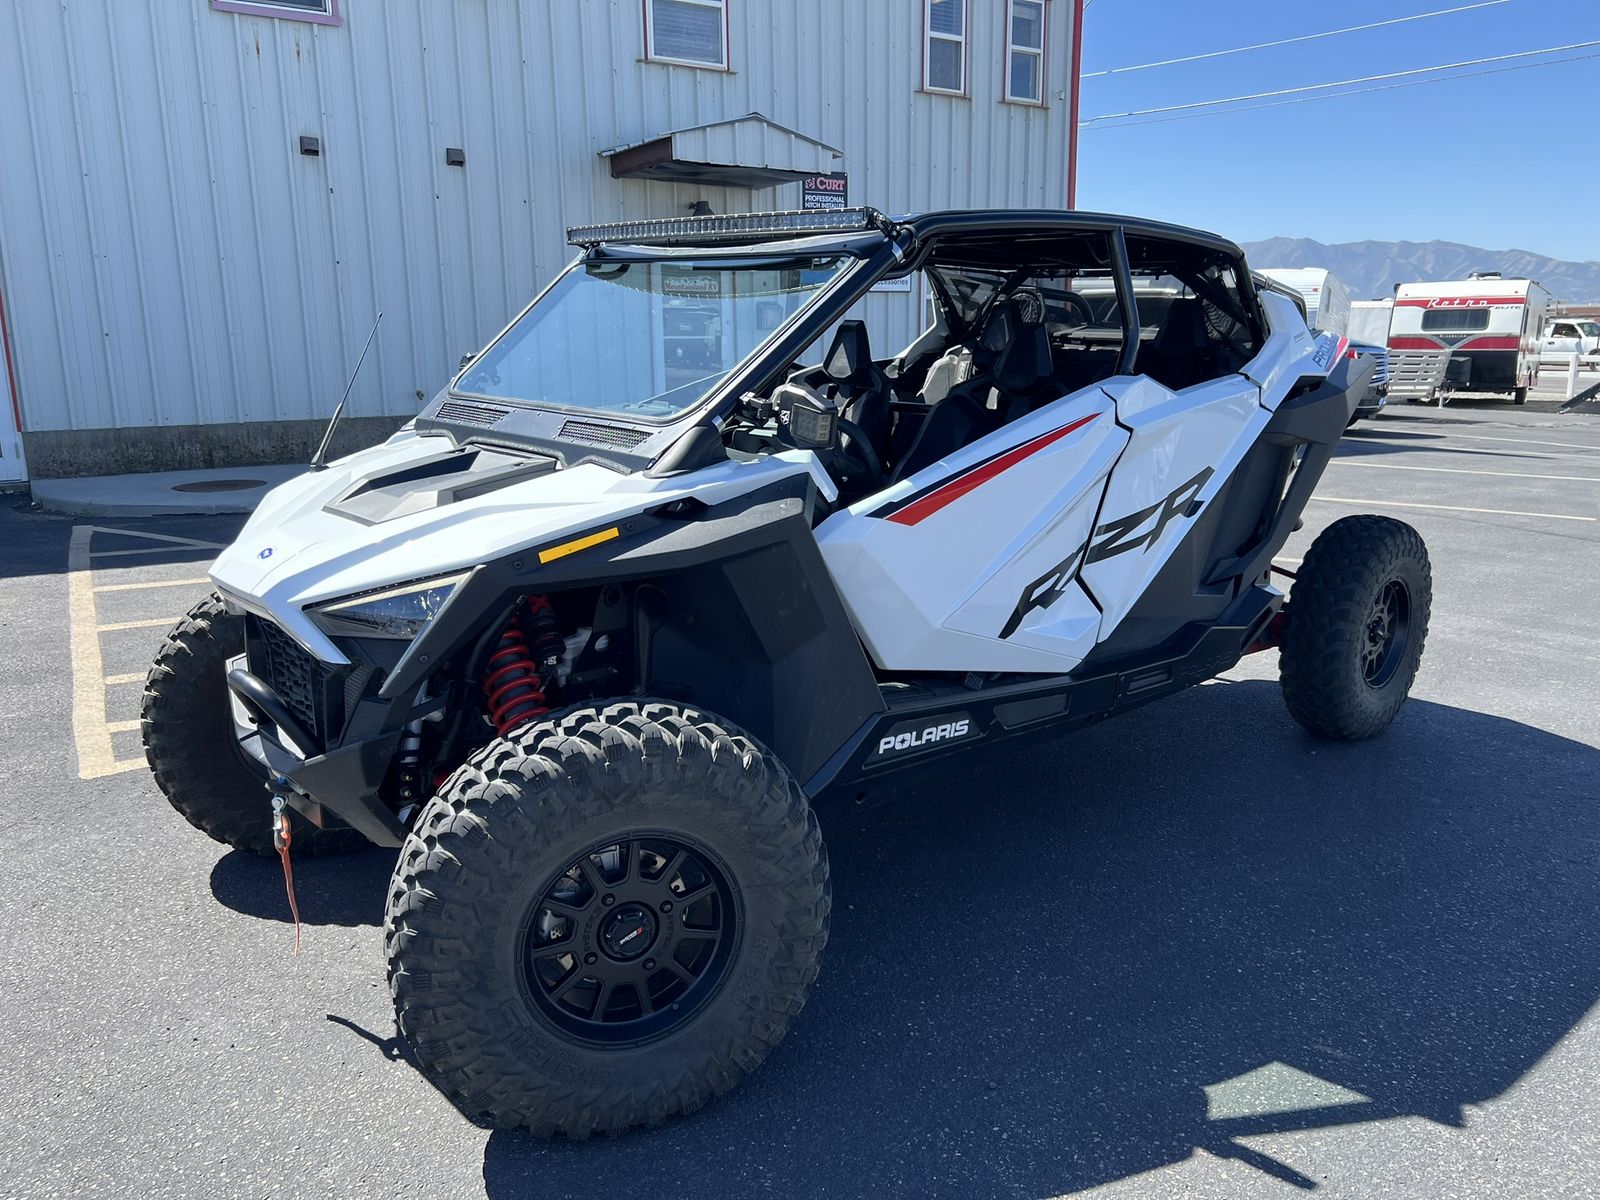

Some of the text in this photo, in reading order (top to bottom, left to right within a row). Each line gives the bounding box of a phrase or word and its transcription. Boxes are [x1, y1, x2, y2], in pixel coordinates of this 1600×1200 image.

[816, 177, 845, 190] CURT
[805, 194, 845, 203] PROFESSIONAL
[1427, 297, 1488, 308] Retro
[998, 466, 1215, 639] RZR
[878, 719, 970, 754] POLARIS
